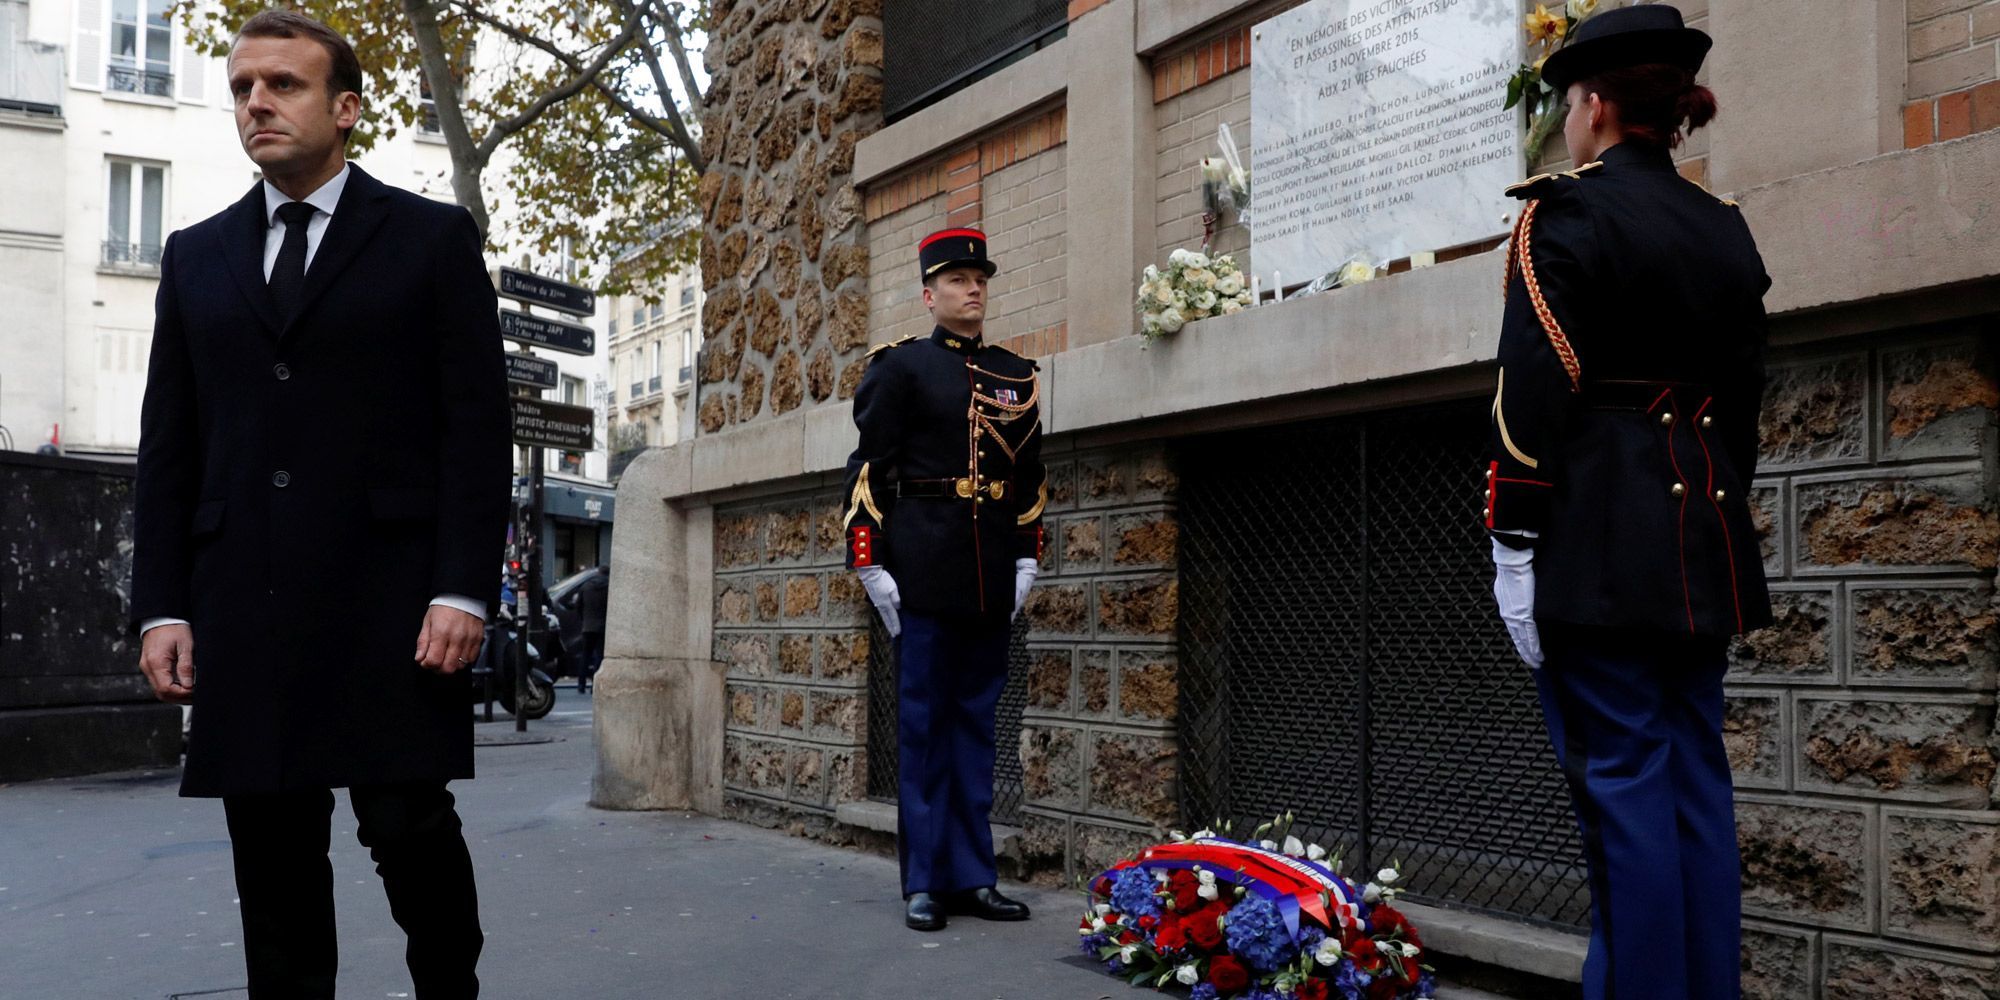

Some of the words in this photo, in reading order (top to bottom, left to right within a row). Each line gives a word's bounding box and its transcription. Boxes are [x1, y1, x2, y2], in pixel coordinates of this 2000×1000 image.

[1291, 38, 1303, 52] EN
[1351, 10, 1367, 27] DES
[1370, 0, 1415, 18] VICTIM
[1294, 55, 1303, 69] ET
[1365, 23, 1382, 40] DES
[1386, 2, 1440, 32] ATTENTATS
[1328, 60, 1337, 73] 13
[1340, 38, 1392, 69] NOVEMBRE
[1395, 28, 1419, 48] 2015
[1319, 82, 1338, 99] AUX
[1341, 78, 1351, 92] 21
[1355, 68, 1375, 85] VIES
[1415, 80, 1455, 100] LUDOVIC
[1377, 114, 1404, 130] CALCIU
[1406, 110, 1413, 120] ET
[1459, 86, 1493, 102] MARIANA
[1342, 145, 1350, 157] DE
[1401, 121, 1425, 138] DIDIER
[1427, 120, 1434, 130] ET
[1436, 113, 1458, 127] LAMIA
[1459, 96, 1506, 118] MONDEGUE
[1399, 143, 1411, 154] GIL
[1254, 202, 1282, 215] THIERRY
[1284, 185, 1328, 205] HARDOUIN
[1330, 183, 1339, 193] ET
[1439, 142, 1477, 159] DJAMILA
[1314, 194, 1352, 212] GUILLAUME
[1354, 189, 1362, 200] LE
[1397, 173, 1423, 187] VICTOR
[1278, 225, 1300, 237] SAADI
[1302, 223, 1309, 231] ET
[1311, 215, 1338, 228] HALIMA
[1341, 204, 1370, 219] NDIAYE
[515, 279, 537, 293] Mairie
[539, 286, 547, 295] du
[514, 316, 544, 332] Gymnase
[547, 324, 564, 335] JAPY
[516, 416, 545, 429] ARTISTIC
